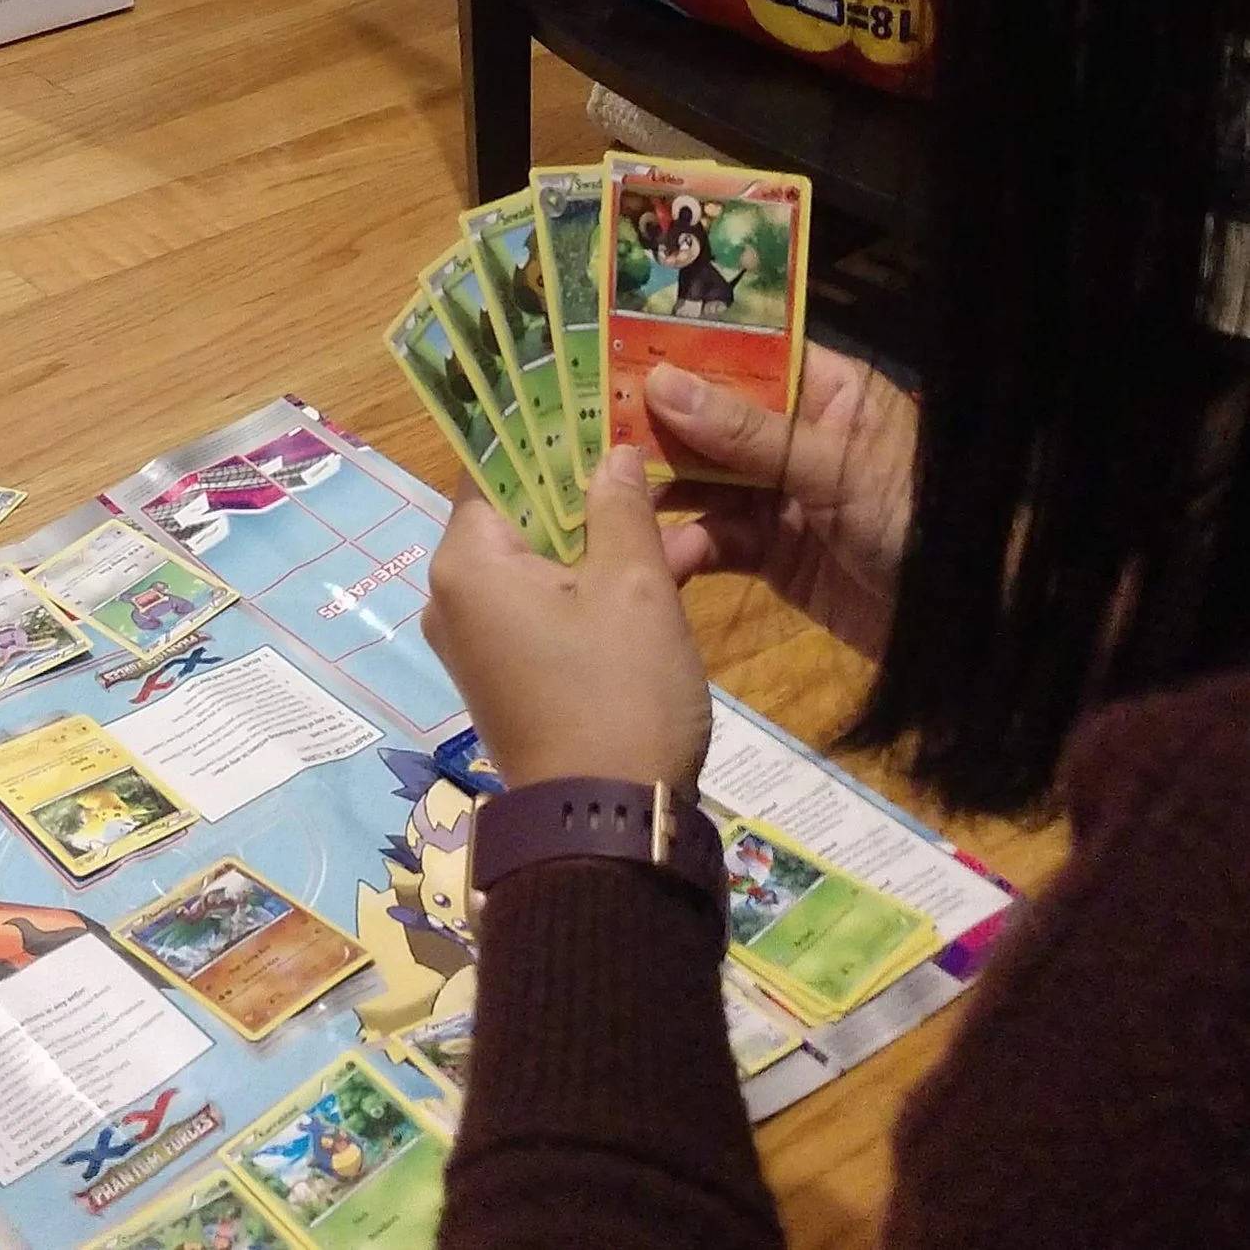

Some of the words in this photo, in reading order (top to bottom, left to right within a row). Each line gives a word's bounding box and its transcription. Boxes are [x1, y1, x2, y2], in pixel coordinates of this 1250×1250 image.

[371, 544, 427, 583] PRIZE
[128, 646, 223, 703] XY
[59, 1088, 179, 1182] XY
